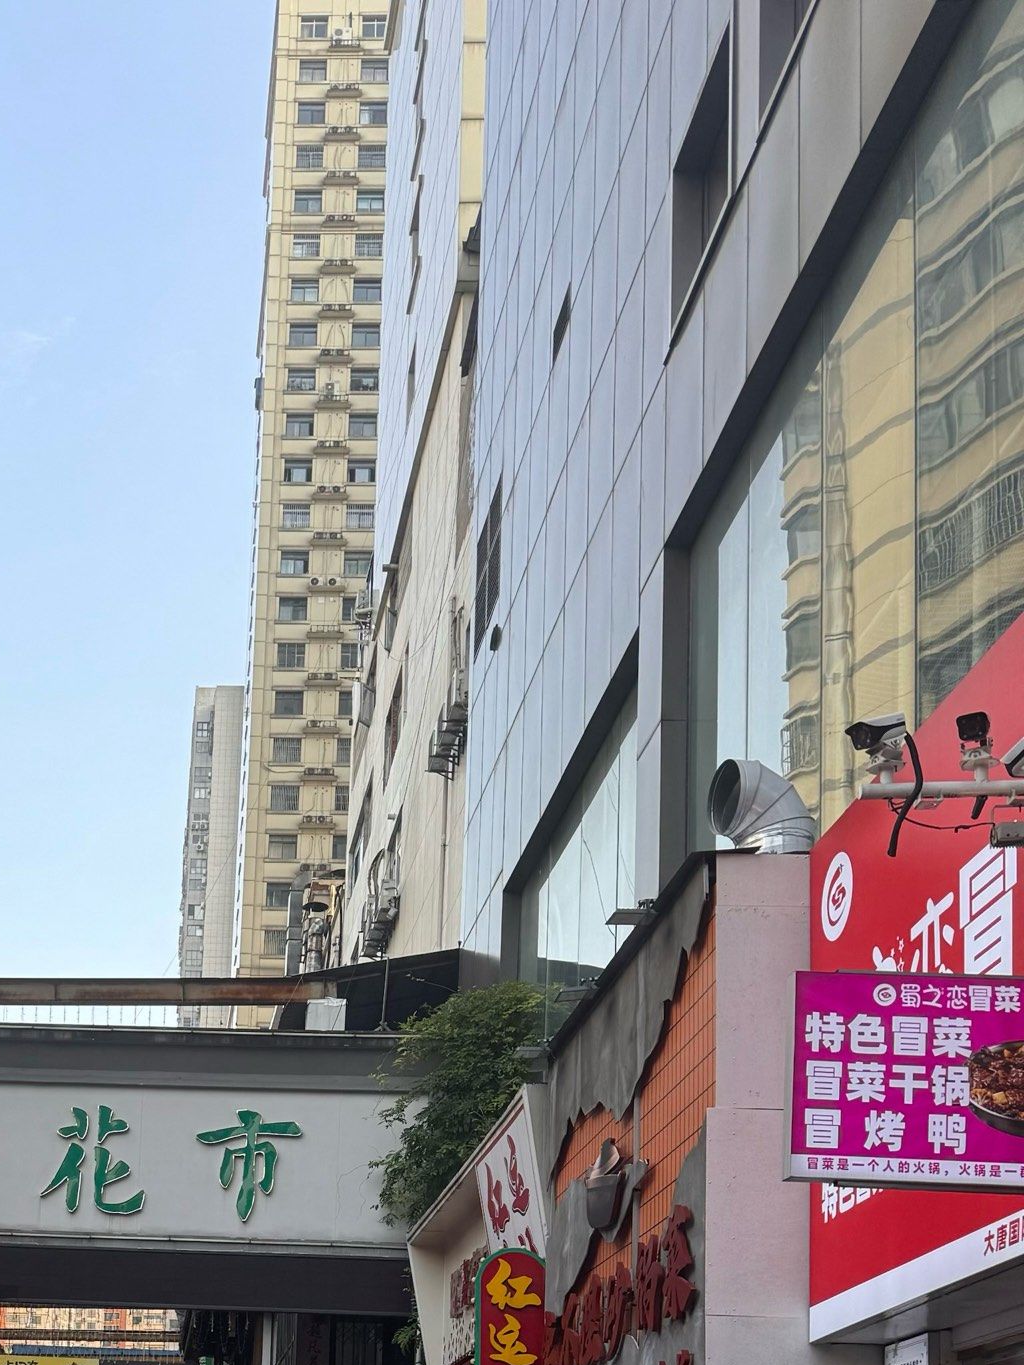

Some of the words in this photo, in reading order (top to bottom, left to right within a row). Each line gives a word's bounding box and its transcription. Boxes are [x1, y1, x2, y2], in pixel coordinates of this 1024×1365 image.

[900, 983, 1022, 1014] 蜀之恋冒菜
[804, 1011, 973, 1059] 特色冒菜
[805, 1059, 971, 1108] 冒菜干锅
[804, 1108, 967, 1156] 冒烤鸭
[807, 1157, 1024, 1179] 冒菜是一个人的火锅，火锅是一
[982, 1215, 1024, 1257] 大唐国
